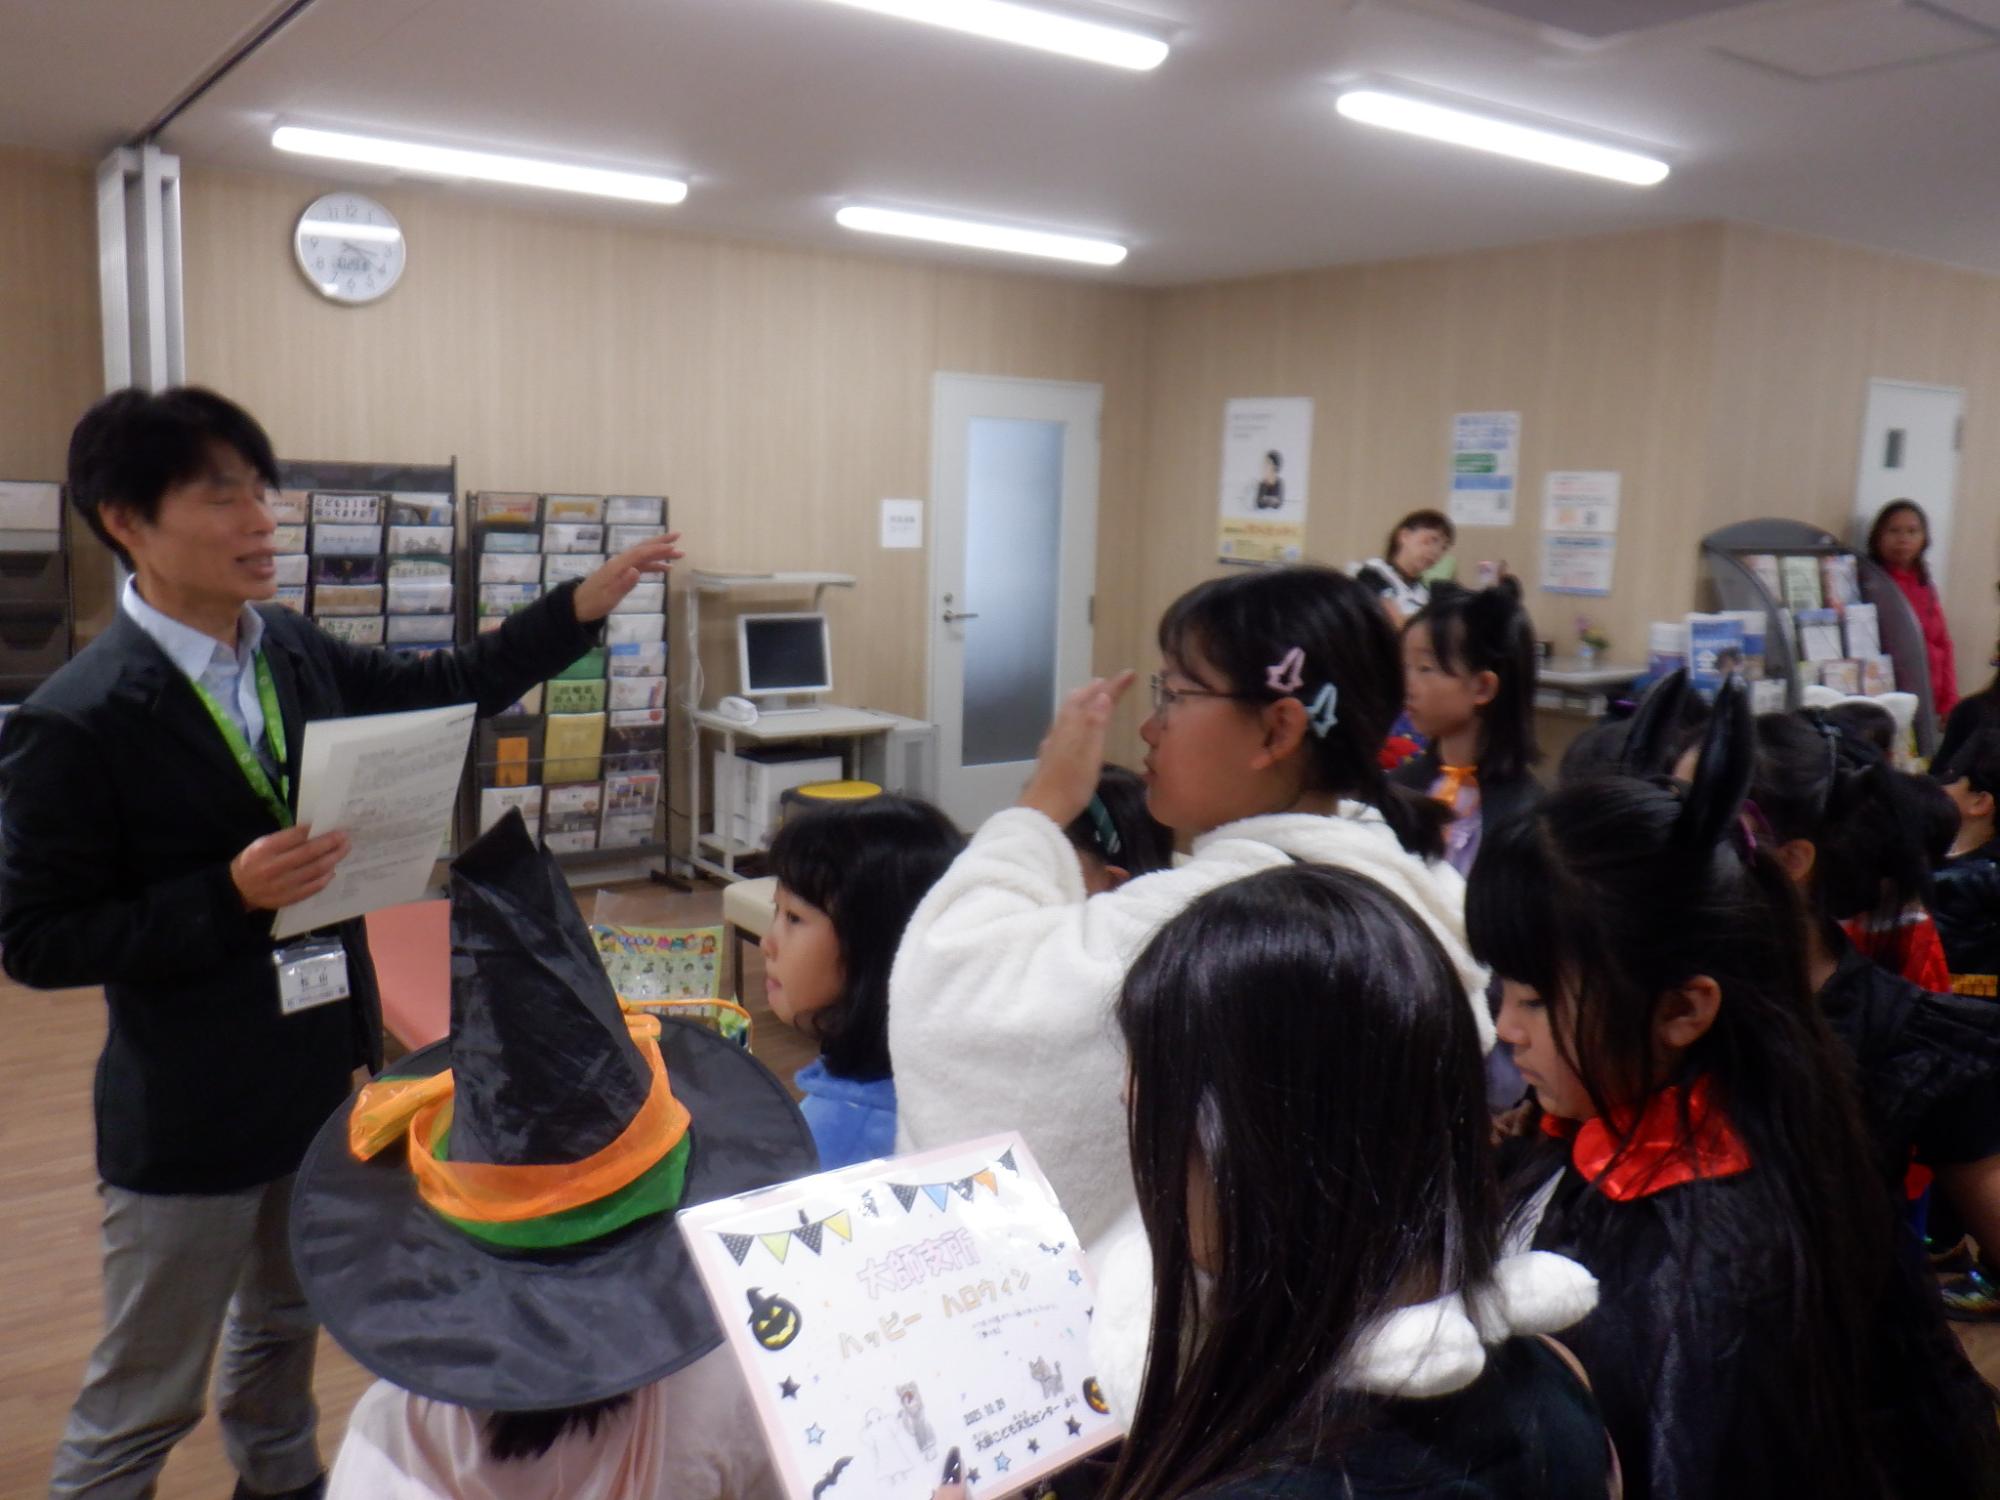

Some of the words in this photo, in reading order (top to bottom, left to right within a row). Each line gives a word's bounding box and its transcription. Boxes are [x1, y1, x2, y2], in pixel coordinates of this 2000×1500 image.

[856, 1226, 981, 1301] 大師支所
[838, 1311, 922, 1360] ハッピー
[942, 1267, 1031, 1319] ハロウィン
